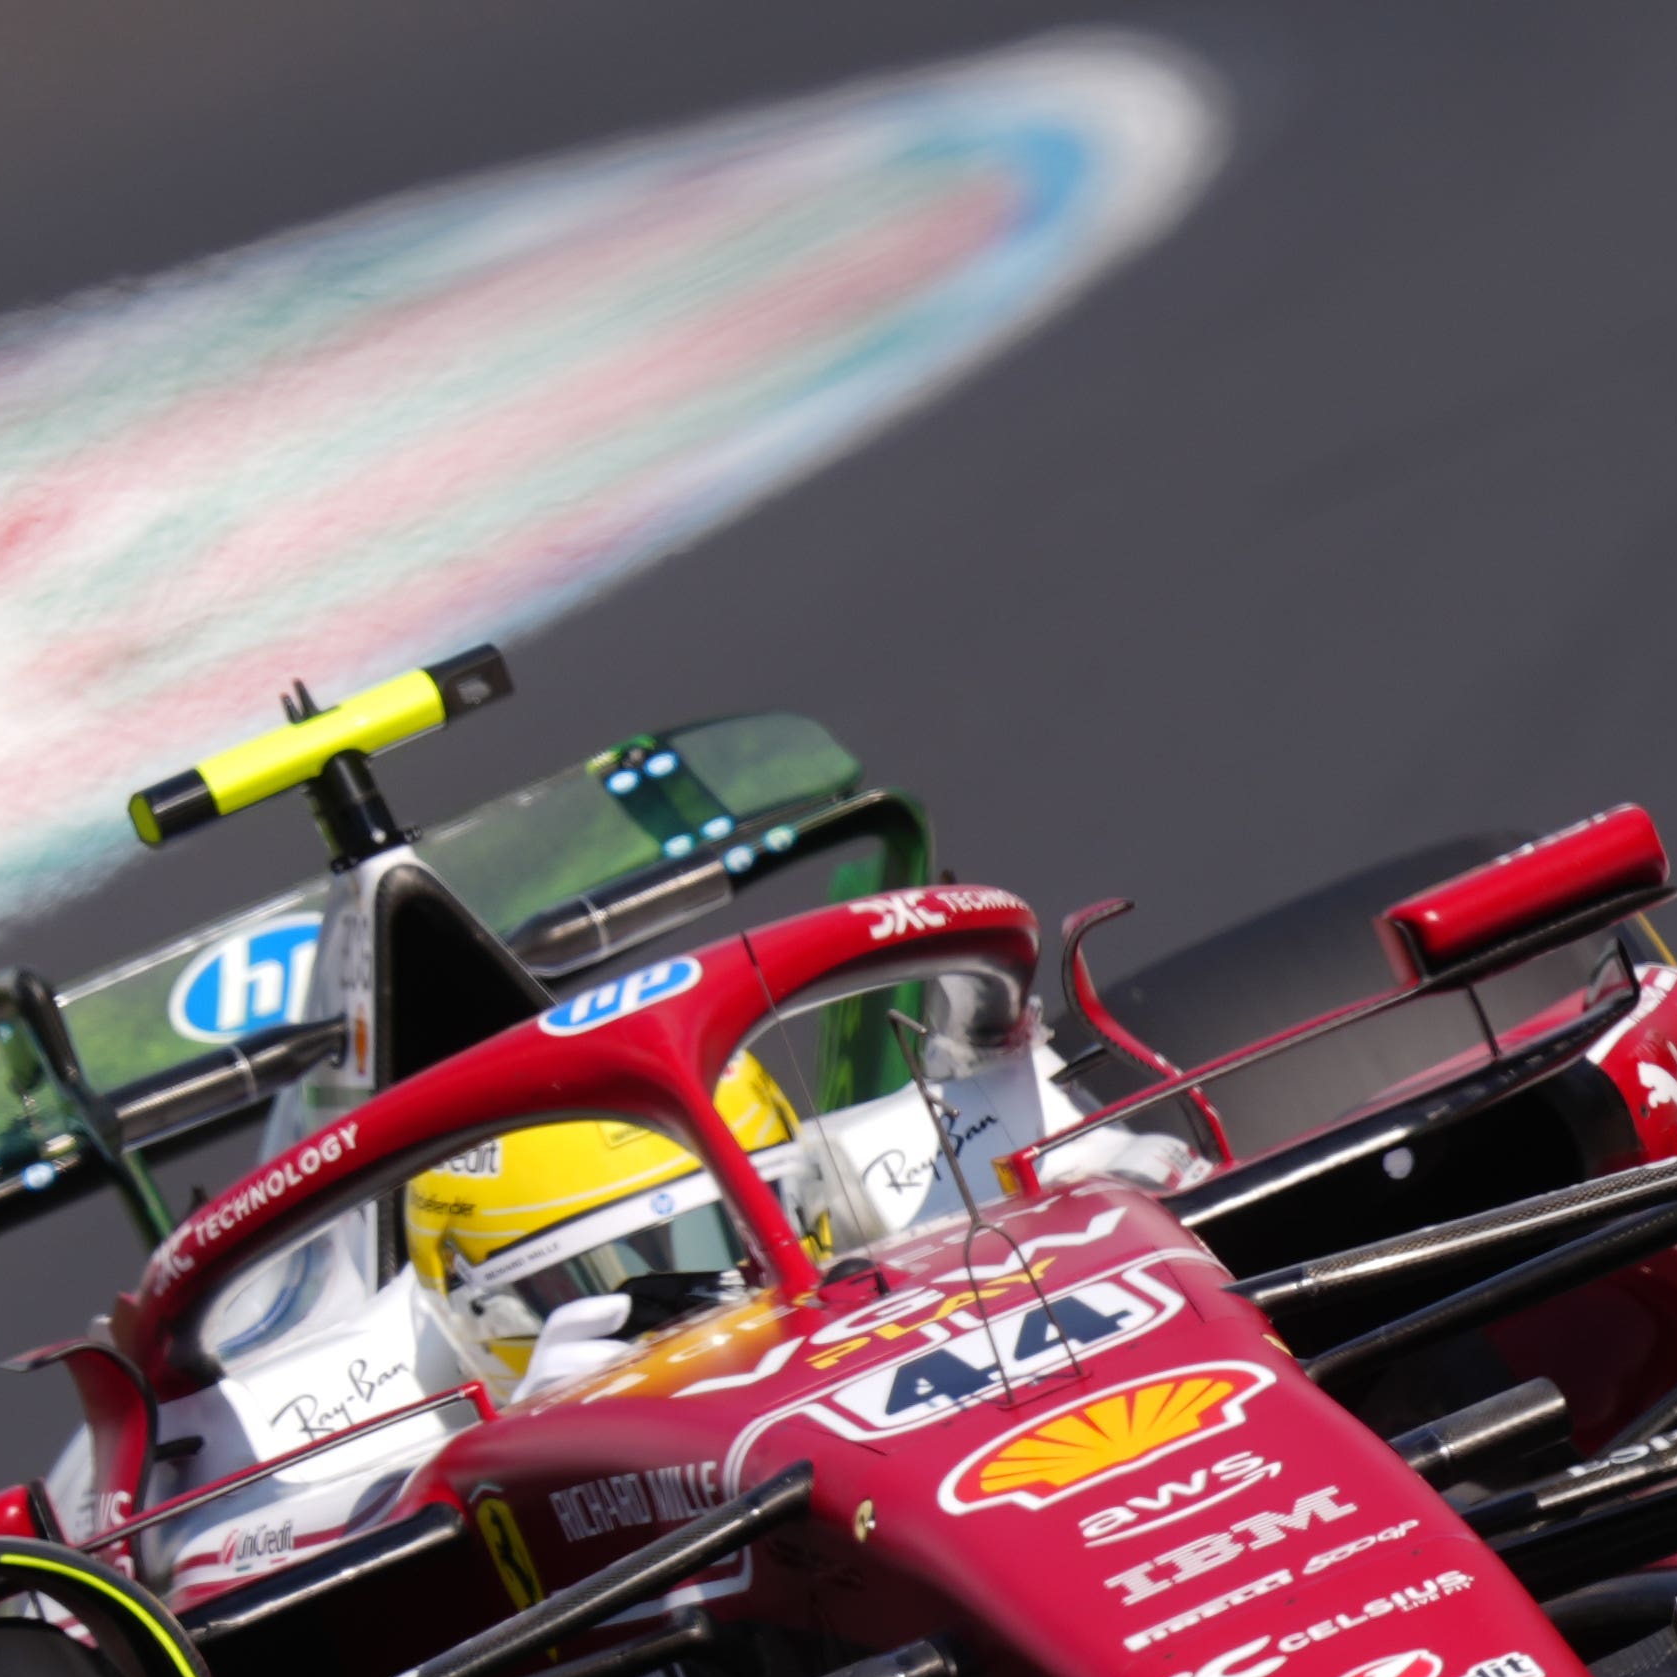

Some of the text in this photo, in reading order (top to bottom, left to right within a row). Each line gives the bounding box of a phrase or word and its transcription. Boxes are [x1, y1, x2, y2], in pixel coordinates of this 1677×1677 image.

[848, 889, 947, 940] DXC
[195, 1121, 360, 1247] TECHNOLOGY
[806, 1256, 1057, 1370] PLAY
[884, 1295, 1132, 1416] 44
[269, 1358, 410, 1442] Ray-Ban
[548, 1460, 718, 1544] RICHARD MILLE
[1078, 1450, 1265, 1540] aws
[1103, 1485, 1359, 1607] IBM
[1277, 1568, 1475, 1654] CELSIUS
